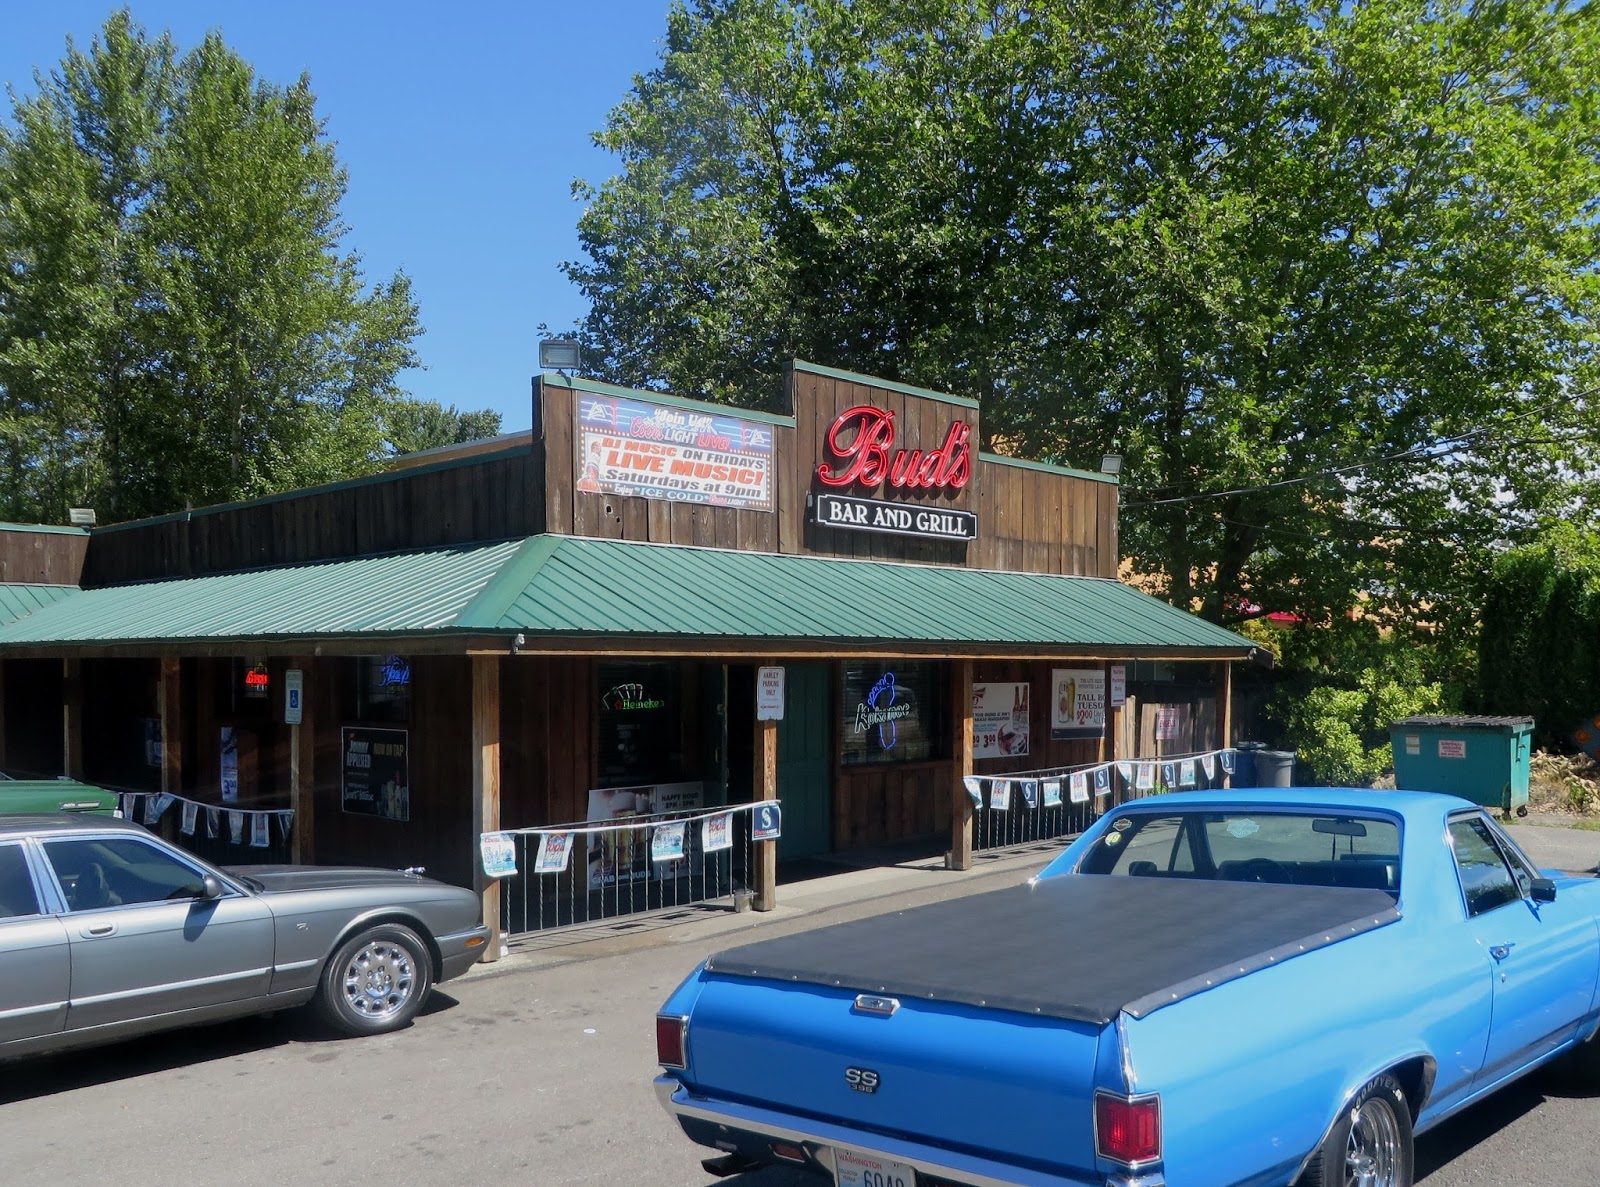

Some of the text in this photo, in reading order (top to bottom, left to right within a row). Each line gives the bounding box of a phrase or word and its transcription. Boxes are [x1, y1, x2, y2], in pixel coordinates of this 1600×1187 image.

[630, 416, 731, 450] Coors LIGHT LIVE!
[818, 405, 970, 488] Bud's
[602, 437, 764, 470] DJ MUSIC ON FRIDAYS
[606, 450, 764, 486] LIVE MUSIC!
[605, 469, 761, 498] Saturdays at 9pm
[614, 483, 633, 496] Enjoy
[728, 499, 747, 507] LIGHT
[829, 501, 967, 535] BAR AND GRILL
[393, 744, 405, 757] TAP
[845, 1068, 877, 1087] SS
[838, 1153, 882, 1170] WASHINGTON
